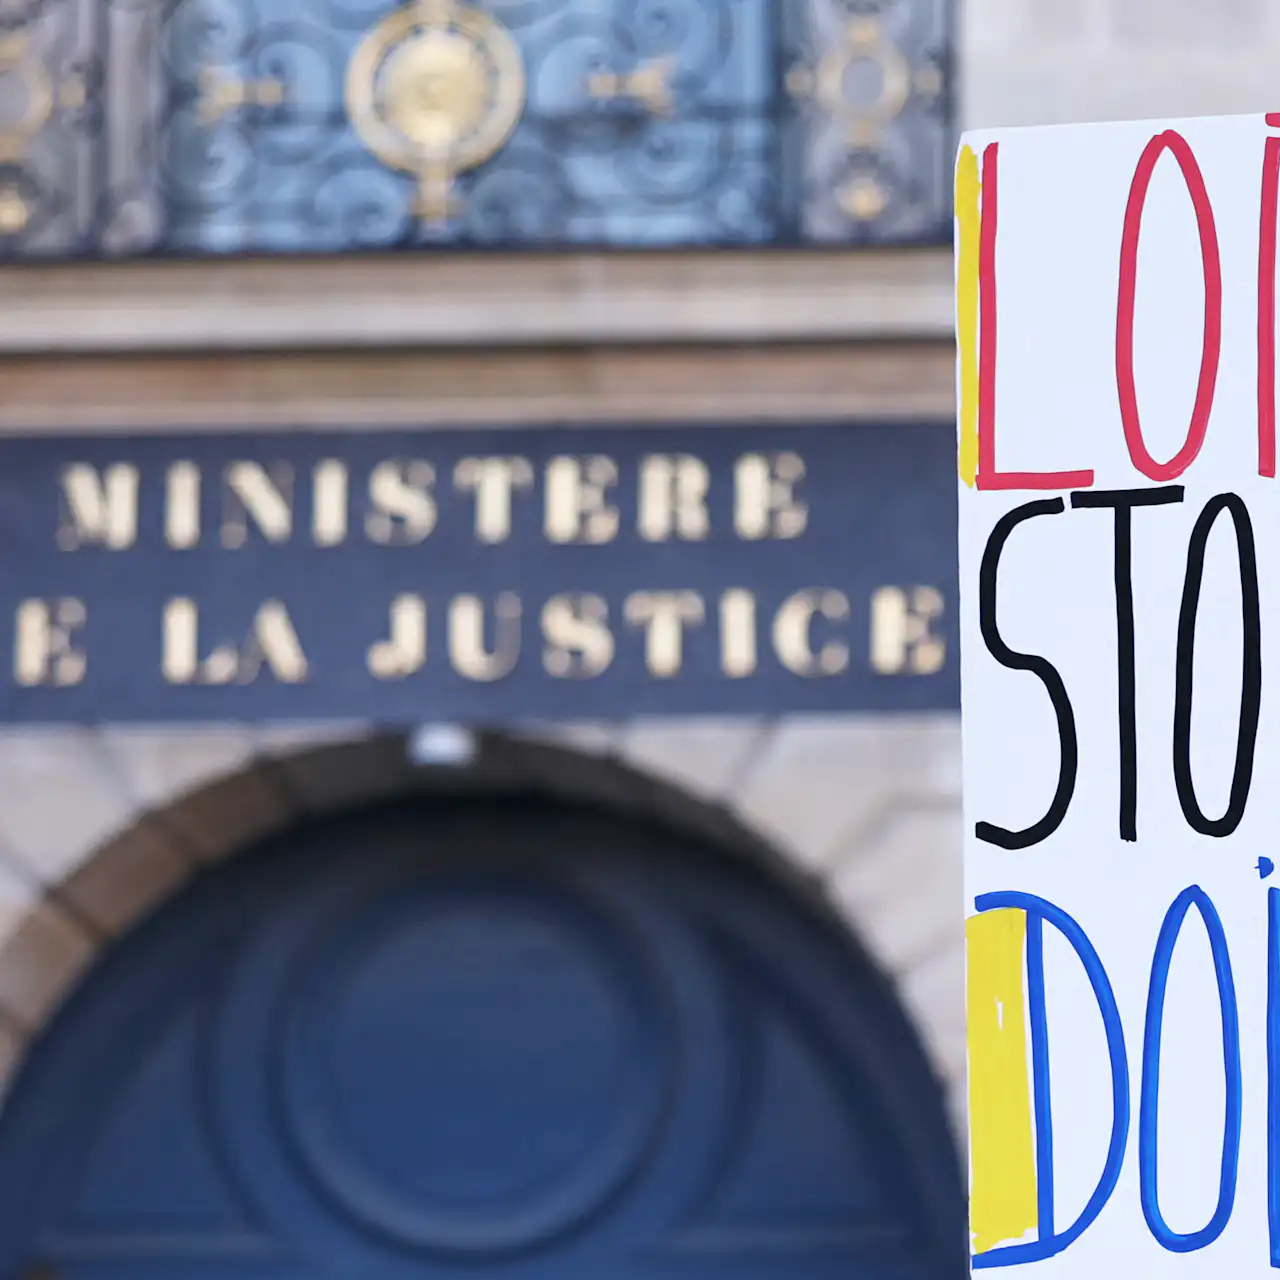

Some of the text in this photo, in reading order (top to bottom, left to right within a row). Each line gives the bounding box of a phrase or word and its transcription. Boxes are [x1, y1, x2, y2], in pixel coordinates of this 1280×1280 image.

[57, 453, 808, 549] MINISTERE
[162, 597, 309, 685] LA
[366, 585, 947, 681] JUSTICE
